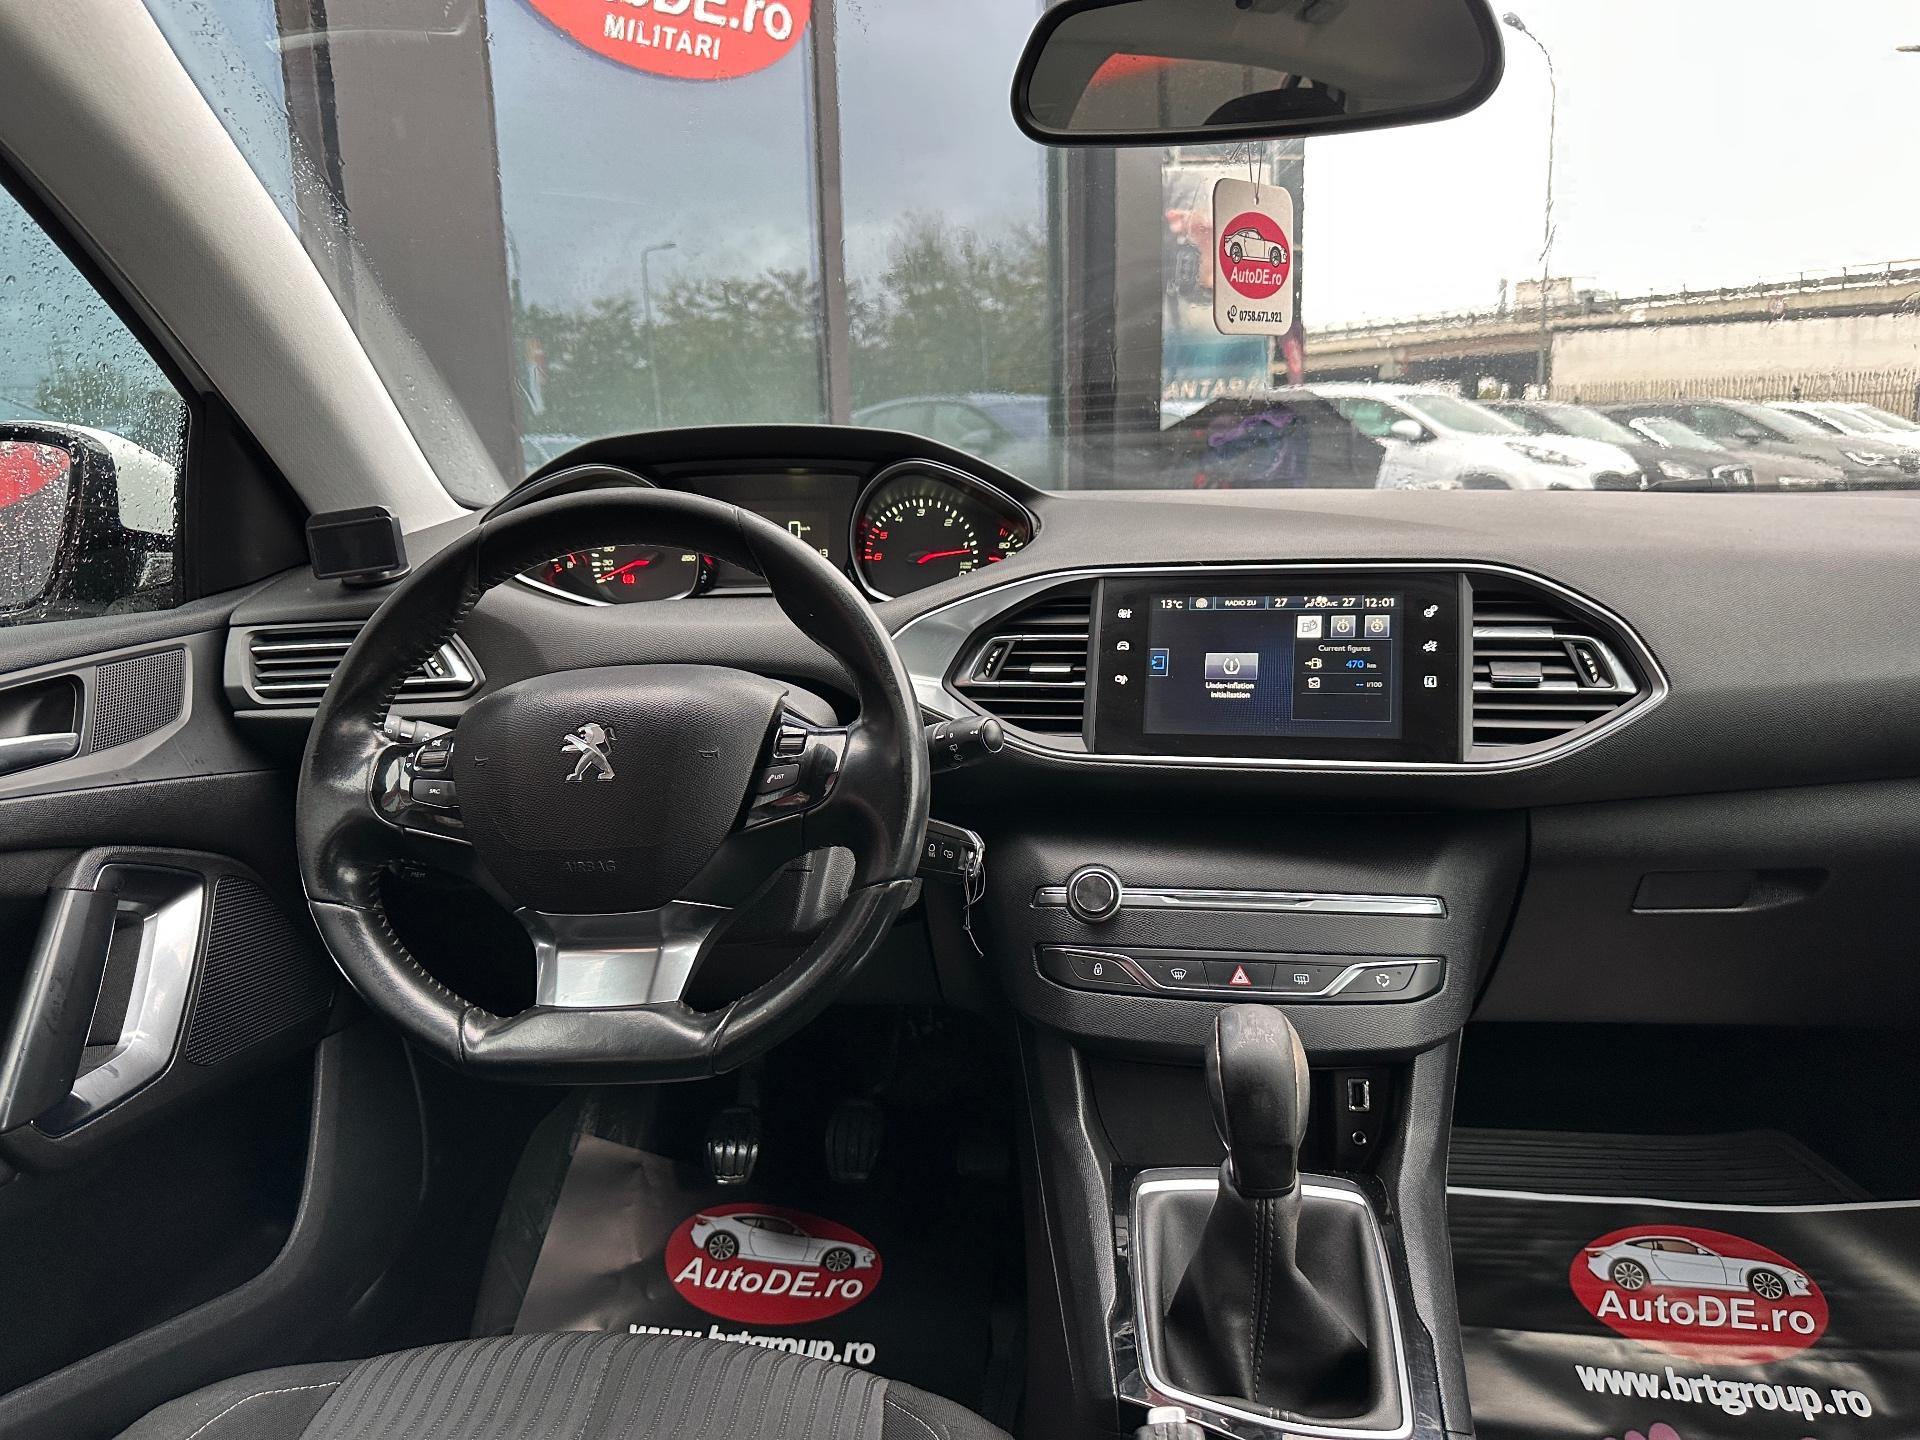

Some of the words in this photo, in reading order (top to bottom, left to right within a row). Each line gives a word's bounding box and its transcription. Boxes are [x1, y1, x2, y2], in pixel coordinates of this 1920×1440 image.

[603, 12, 721, 60] MILITARI
[1230, 266, 1282, 286] AutoDE.ro
[1239, 310, 1283, 323] 0758.671.921
[916, 508, 926, 517] 3
[894, 514, 903, 523] 4
[943, 518, 954, 527] 2
[1160, 599, 1183, 609] 13°C
[1224, 599, 1245, 607] RADIO
[1246, 599, 1257, 607] ZU
[1274, 598, 1288, 607] 27
[1342, 597, 1356, 607] 27
[1364, 598, 1395, 608] 12:01
[1318, 644, 1346, 652] Current
[1347, 644, 1371, 653] figures
[1345, 660, 1365, 669] 470
[1205, 681, 1255, 690] Under-inflation
[674, 1257, 864, 1298] AutoDE.ro
[1597, 1290, 1816, 1335] AutoDE.ro
[1575, 1365, 1872, 1421] www.brtgroup.ro
